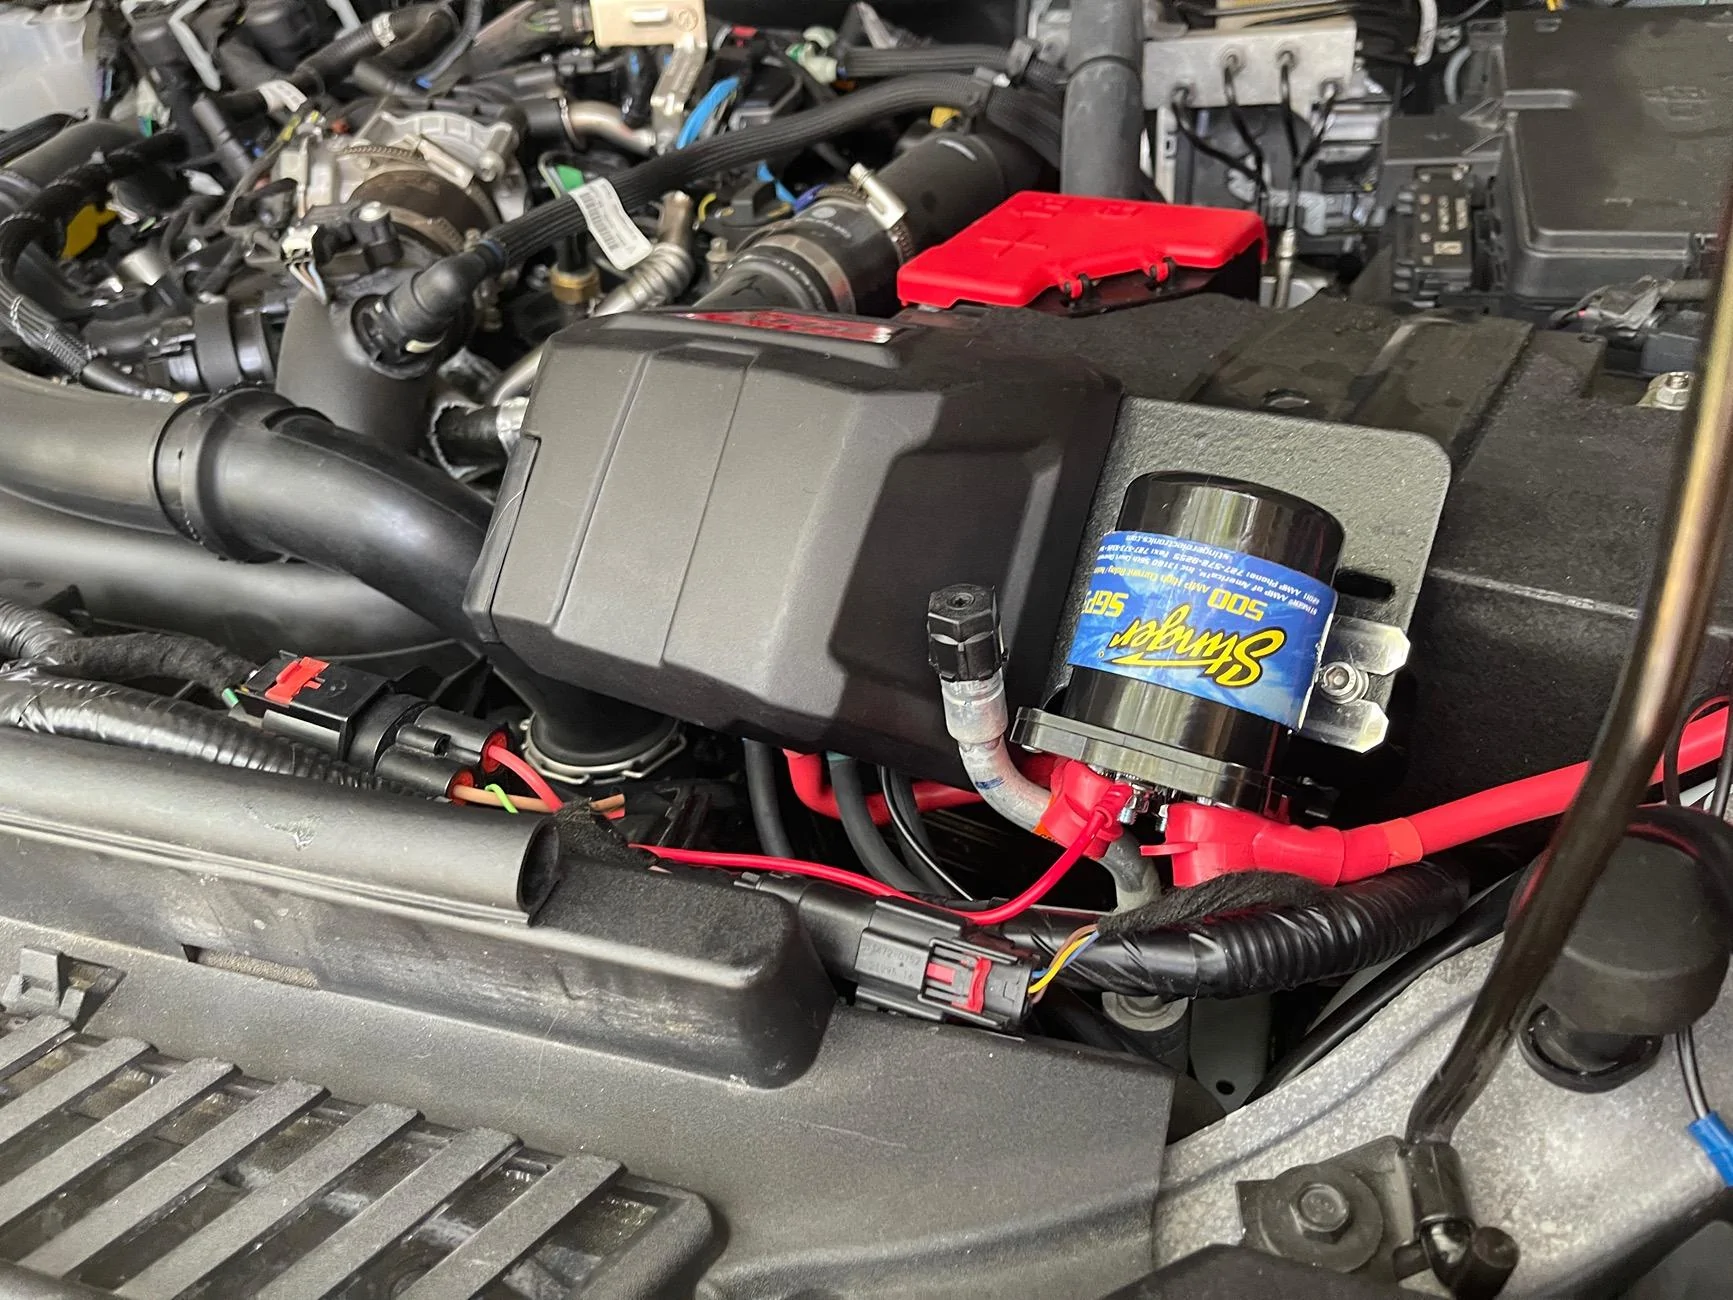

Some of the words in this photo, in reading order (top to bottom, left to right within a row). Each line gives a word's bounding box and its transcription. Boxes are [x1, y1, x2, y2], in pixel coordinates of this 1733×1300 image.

[1184, 581, 1211, 593] AMP
[1207, 588, 1268, 621] 500
[1110, 604, 1285, 688] Stinger
